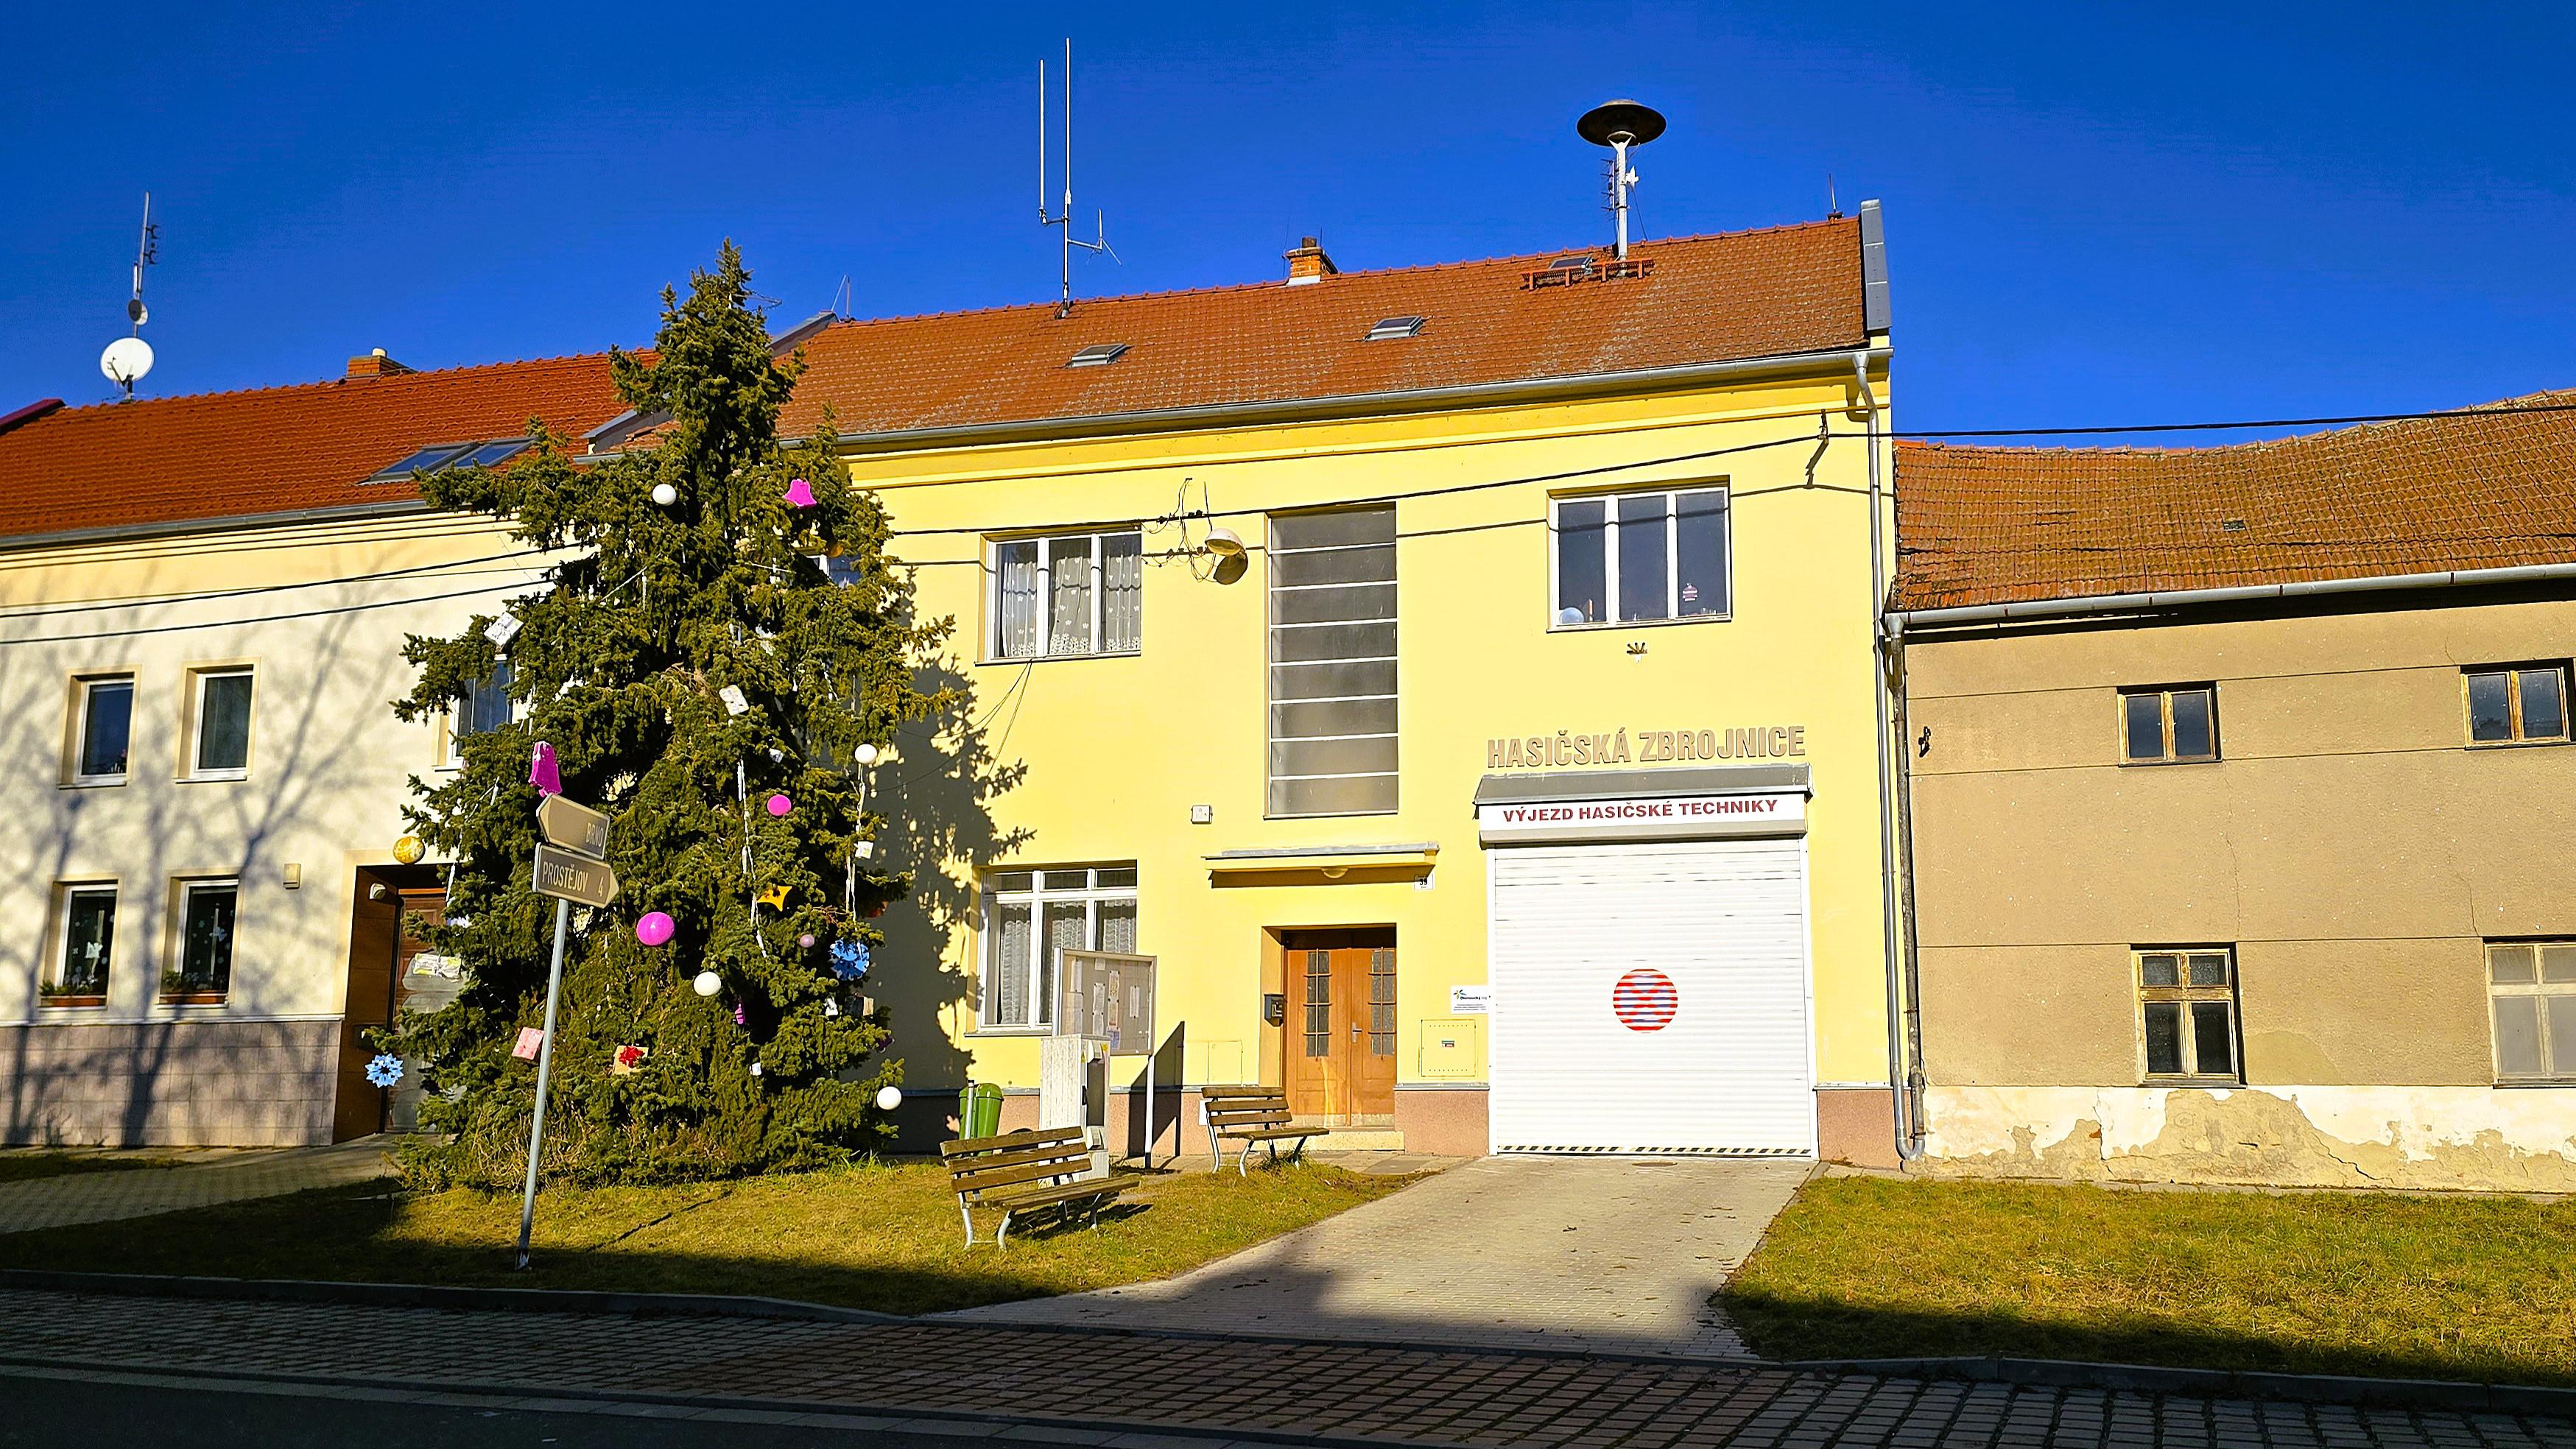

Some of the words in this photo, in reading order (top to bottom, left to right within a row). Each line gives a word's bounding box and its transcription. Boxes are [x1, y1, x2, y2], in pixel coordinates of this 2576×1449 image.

[1488, 727, 1631, 768] HASIČSKÁ
[1639, 726, 1806, 762] ZBROJNICE
[1503, 806, 1574, 822] VÝJEZD
[1579, 801, 1673, 819] HASIČSKÉ
[1678, 800, 1778, 816] TECHNIKY
[585, 822, 604, 847] BRNO
[542, 861, 588, 893] PROSTĚJOV
[597, 876, 604, 897] 4
